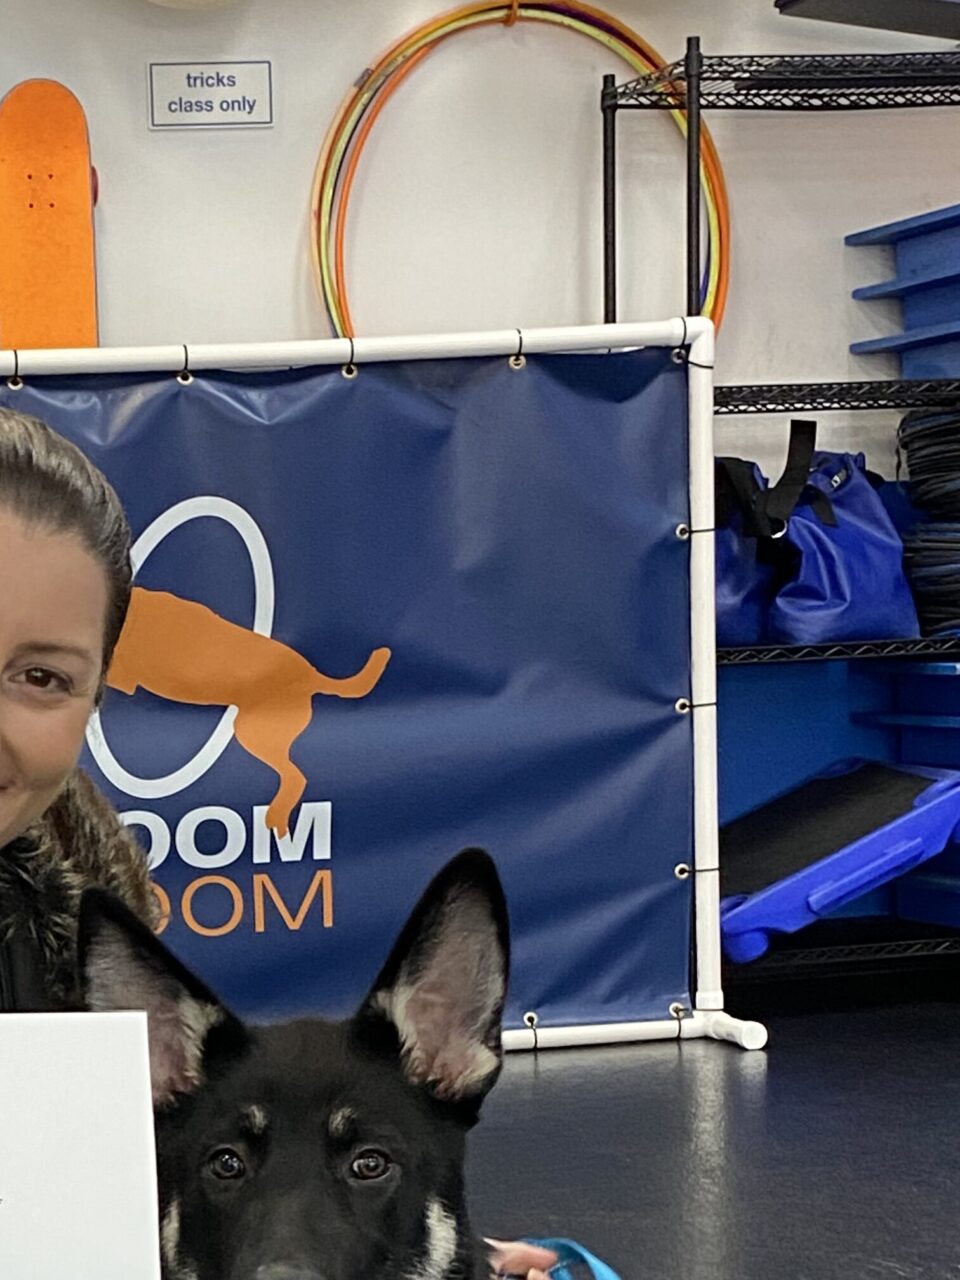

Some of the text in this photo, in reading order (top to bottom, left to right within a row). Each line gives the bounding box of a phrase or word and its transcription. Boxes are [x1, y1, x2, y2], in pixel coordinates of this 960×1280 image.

[186, 71, 236, 88] tricks
[168, 95, 256, 115] class only
[117, 801, 332, 871] OOM
